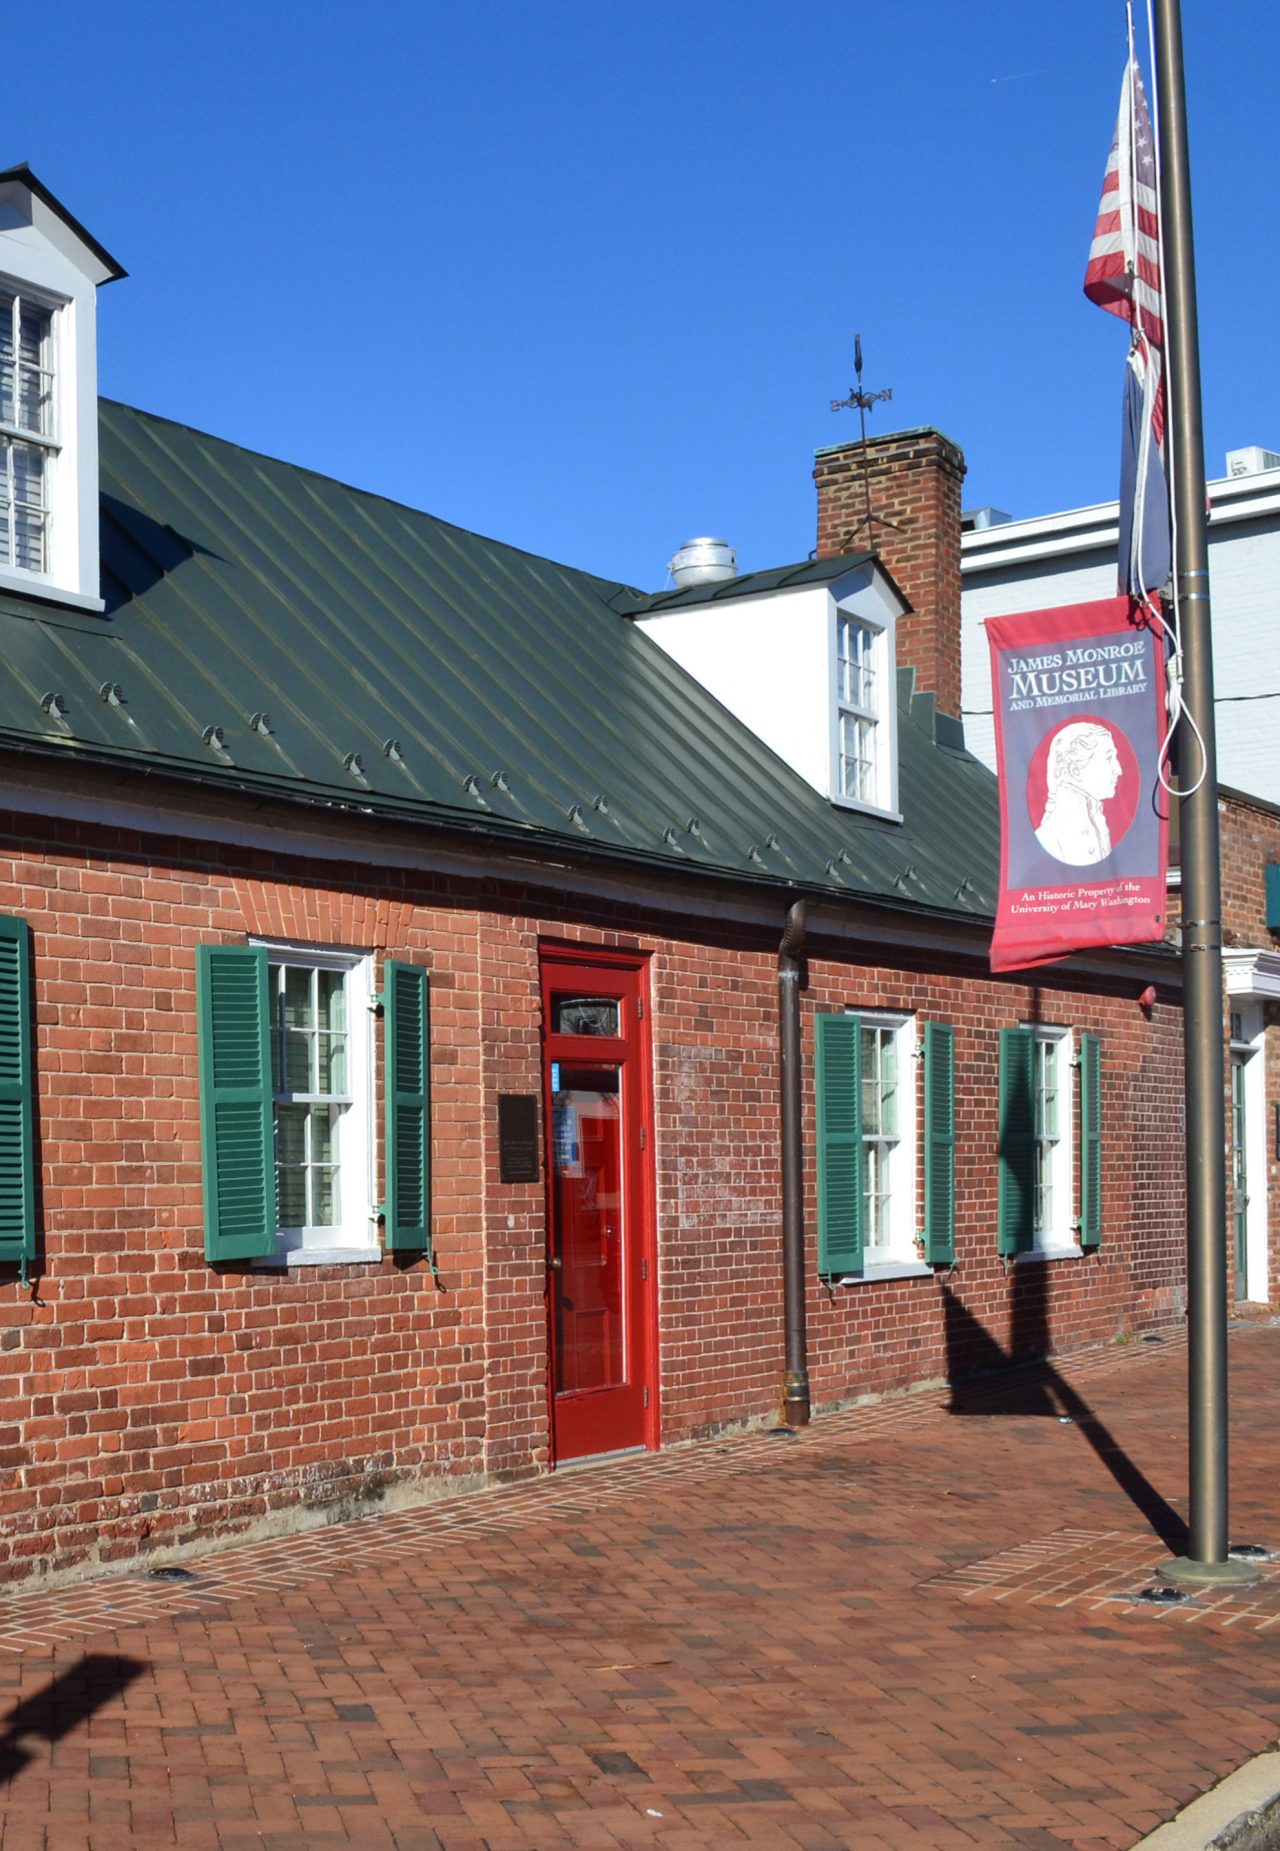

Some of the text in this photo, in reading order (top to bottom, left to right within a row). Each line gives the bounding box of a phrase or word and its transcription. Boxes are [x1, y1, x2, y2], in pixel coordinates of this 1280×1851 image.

[1008, 641, 1146, 674] JAMES MONROE
[1009, 659, 1147, 699] MUSEUM
[1010, 682, 1147, 711] AND MEMORIAL LIBRARY
[1011, 896, 1150, 914] University of Mary Washington
[1022, 893, 1035, 902] An
[1038, 890, 1075, 900] Historic
[1078, 886, 1115, 898] Property
[1125, 882, 1140, 891] the
